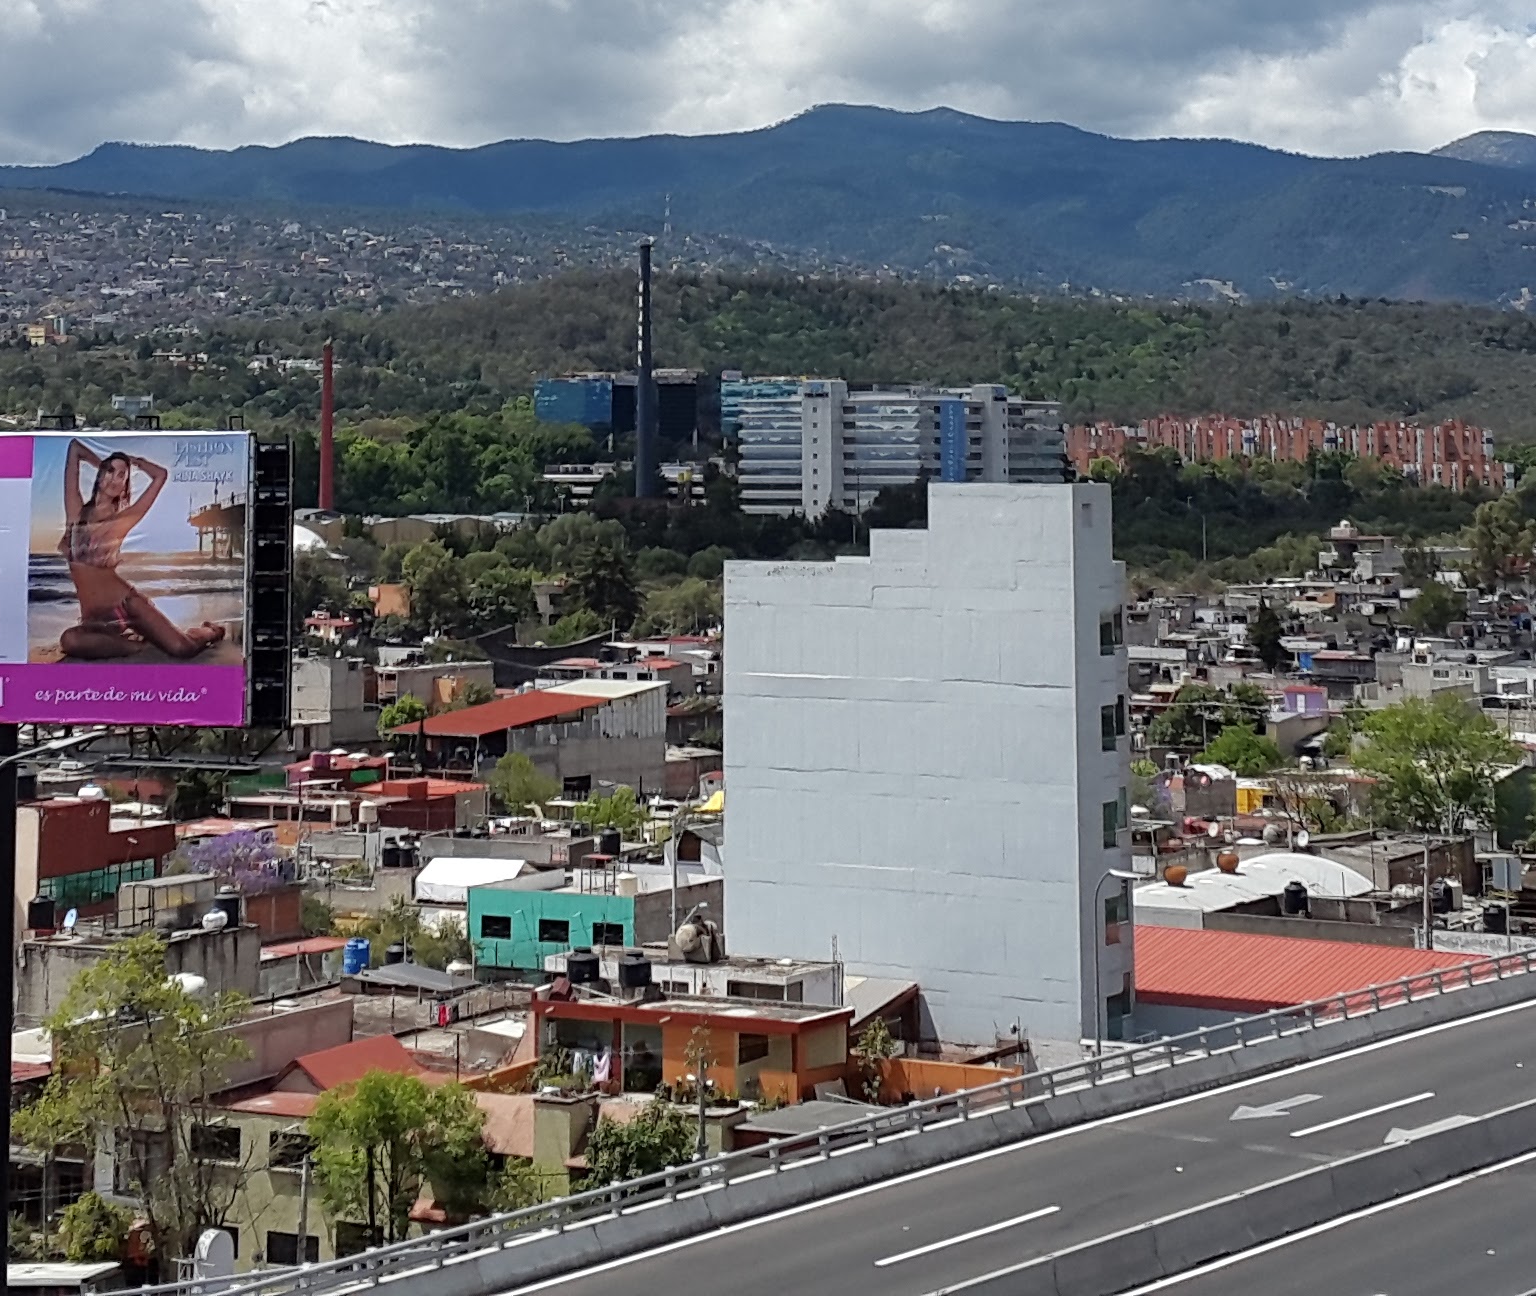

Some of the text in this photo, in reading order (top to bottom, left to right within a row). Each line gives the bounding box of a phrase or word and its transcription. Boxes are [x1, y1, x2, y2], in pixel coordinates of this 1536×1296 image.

[35, 688, 54, 701] es
[55, 687, 103, 704] parte
[103, 686, 127, 701] de
[130, 688, 155, 702] mi
